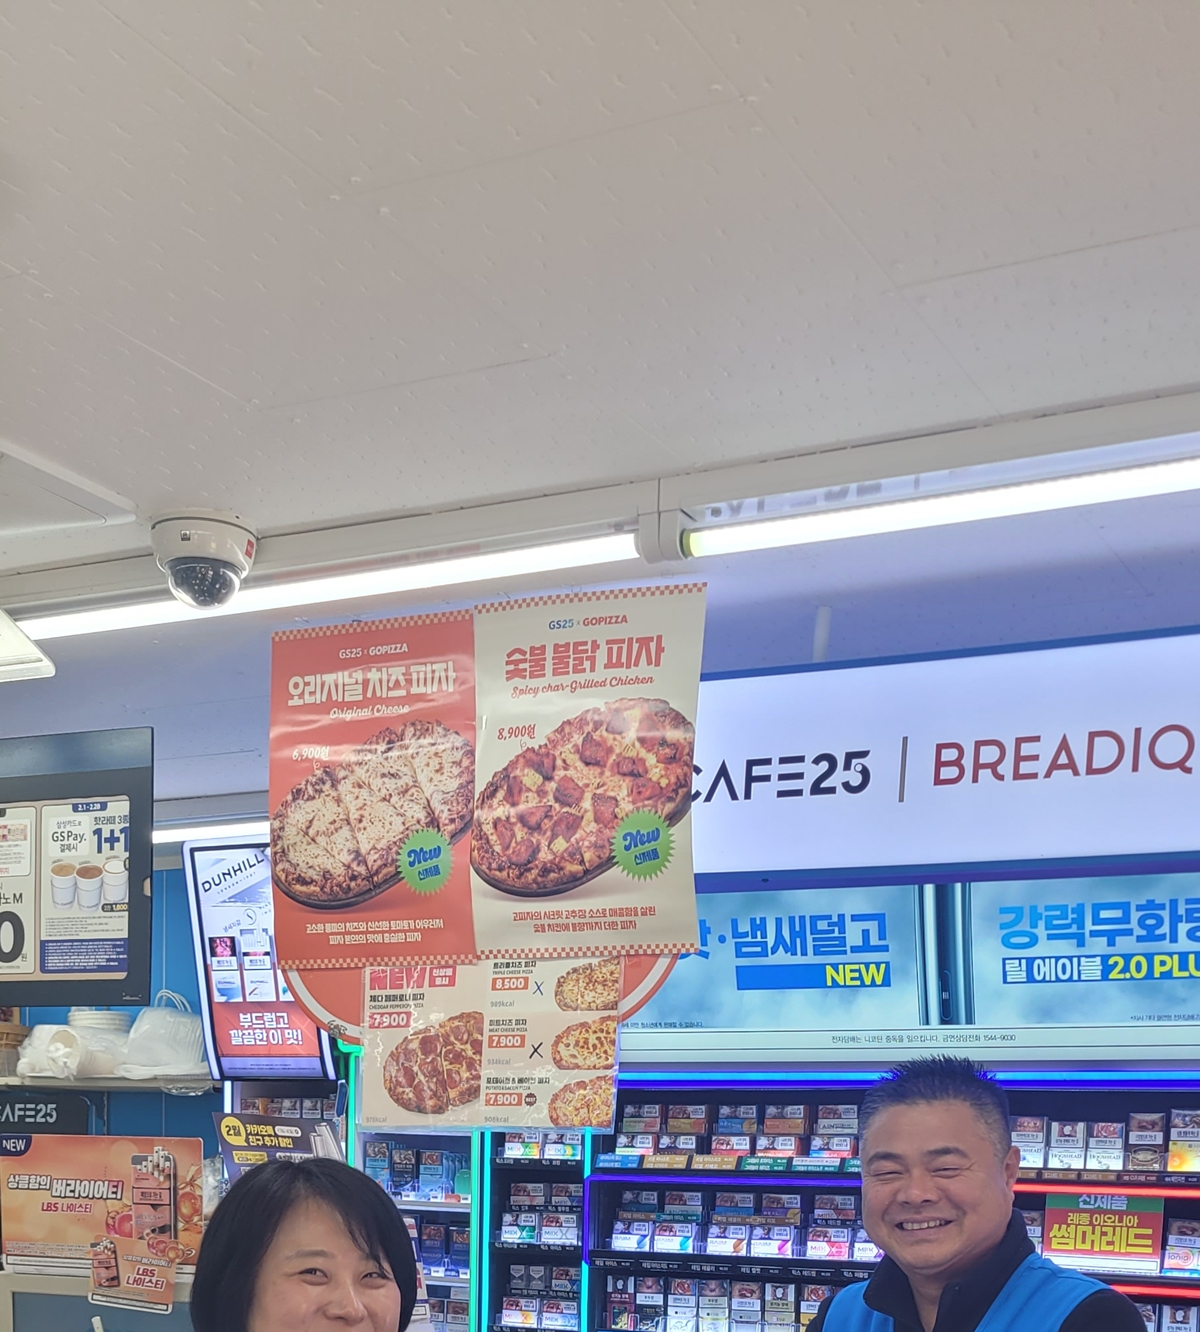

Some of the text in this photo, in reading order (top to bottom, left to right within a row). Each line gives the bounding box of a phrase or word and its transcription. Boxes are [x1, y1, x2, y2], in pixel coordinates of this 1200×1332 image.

[548, 615, 628, 630] GS25 GOPIZZA
[339, 643, 408, 659] GS25 GOPIZZA
[505, 634, 665, 682] 숯불 불닭 피자
[287, 660, 457, 707] 오리지널 치즈 피자
[511, 685, 540, 700] Spicy
[609, 674, 655, 688] Chicken
[329, 704, 411, 721] Original Cheese
[497, 724, 536, 741] 8,900원
[291, 746, 330, 761] 6,900원
[931, 723, 1196, 787] BREADIQ
[93, 826, 129, 854] 1+1
[622, 827, 661, 852] New
[407, 845, 442, 868] New
[634, 848, 660, 866] 신제품
[201, 853, 266, 893] DUNHILL
[418, 864, 441, 881] 신제품
[640, 906, 656, 917] 살린
[604, 921, 618, 930] 더한
[620, 920, 637, 930] 피자
[329, 935, 344, 945] 피자
[407, 932, 421, 942] 피자
[825, 963, 886, 987] NEW
[1005, 958, 1027, 982] 릴
[1033, 956, 1102, 982] 에이블
[1107, 955, 1148, 980] 2.0
[496, 978, 525, 989] 8,500
[239, 1012, 289, 1029] 부드럽고
[229, 1028, 303, 1046] 깔끔한 이 맛!
[492, 1036, 521, 1047] 7,900
[831, 1035, 862, 1044] 전자담배는
[983, 1033, 1016, 1042] 1544-9030
[489, 1094, 518, 1105] 7,900
[2, 1139, 26, 1151] NEW
[7, 1175, 124, 1200] 상큼함의 버라이어티
[41, 1202, 93, 1214] LBS 나이스티
[1078, 1194, 1128, 1210] 신제품
[1068, 1213, 1138, 1227] 레종 이오니아
[1049, 1225, 1153, 1253] 썸머레드
[136, 1267, 156, 1278] LBS
[126, 1276, 166, 1290] 나이스티
